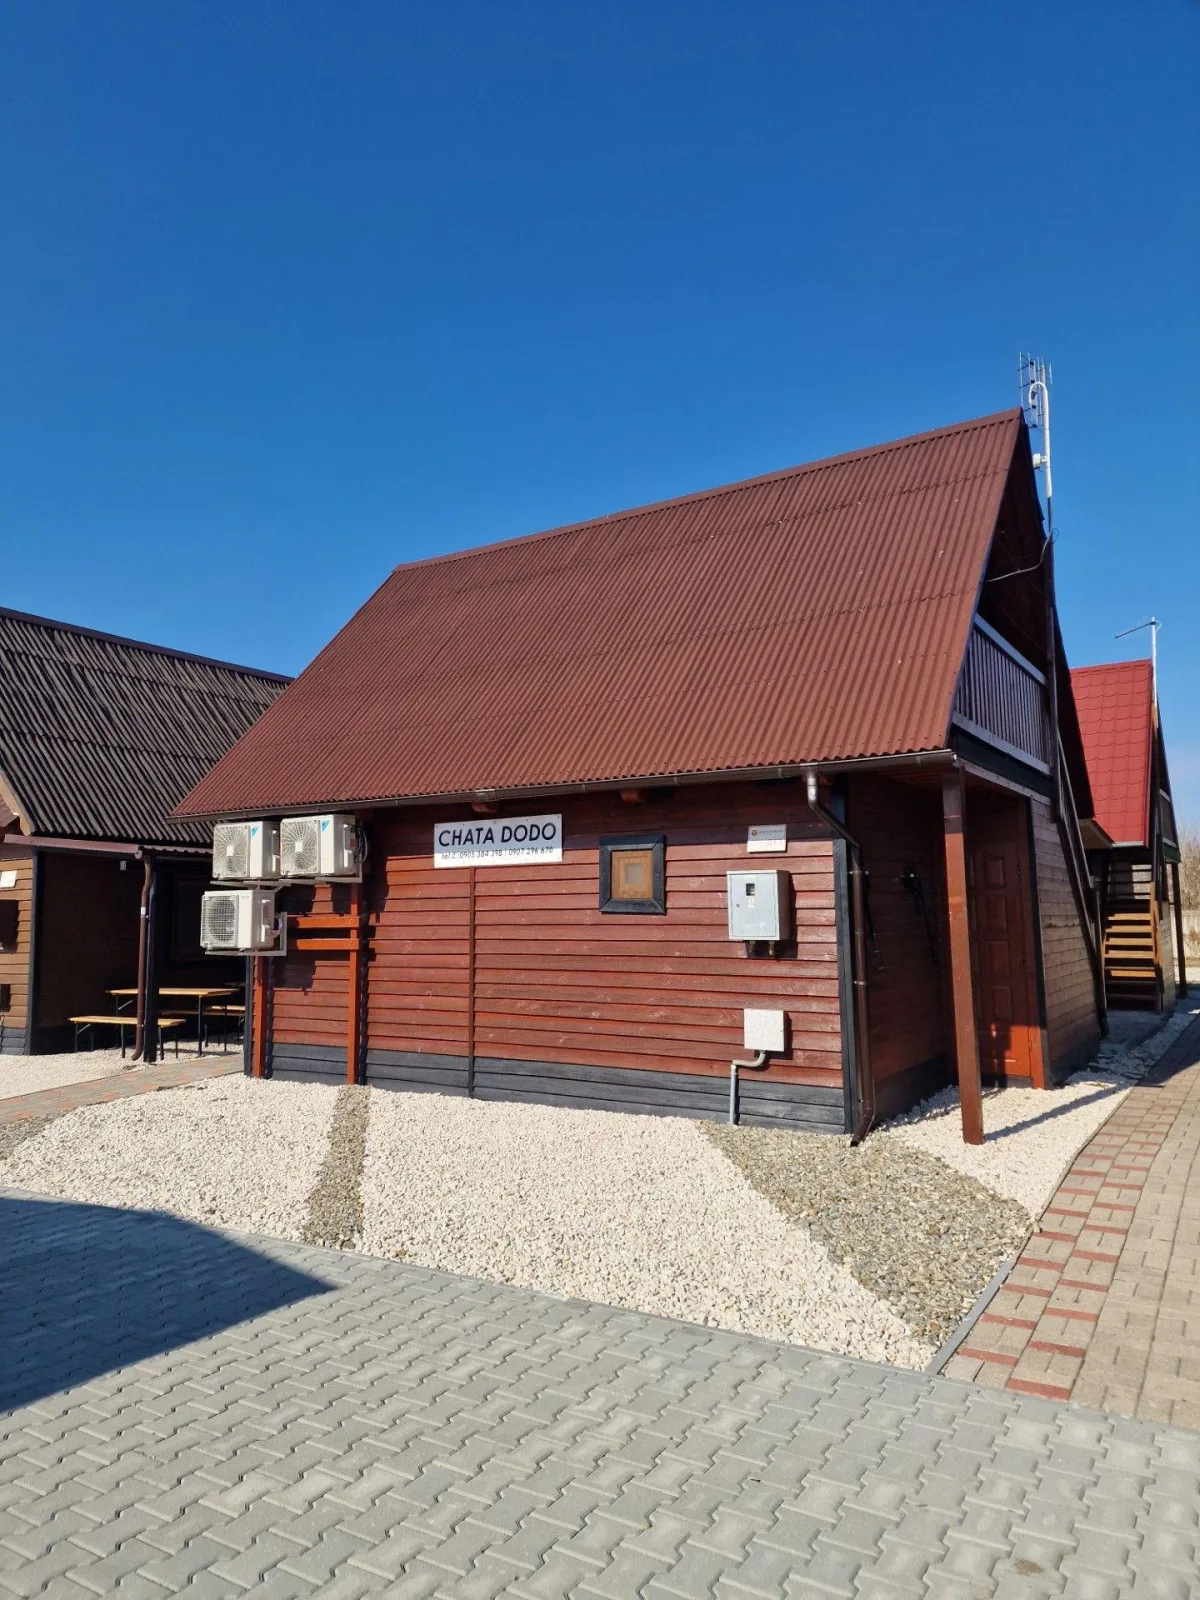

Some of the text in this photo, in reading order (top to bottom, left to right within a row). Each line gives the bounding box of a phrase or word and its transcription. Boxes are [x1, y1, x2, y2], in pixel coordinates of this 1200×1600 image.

[438, 822, 556, 847] CHATA DODO
[508, 848, 525, 856] 0907
